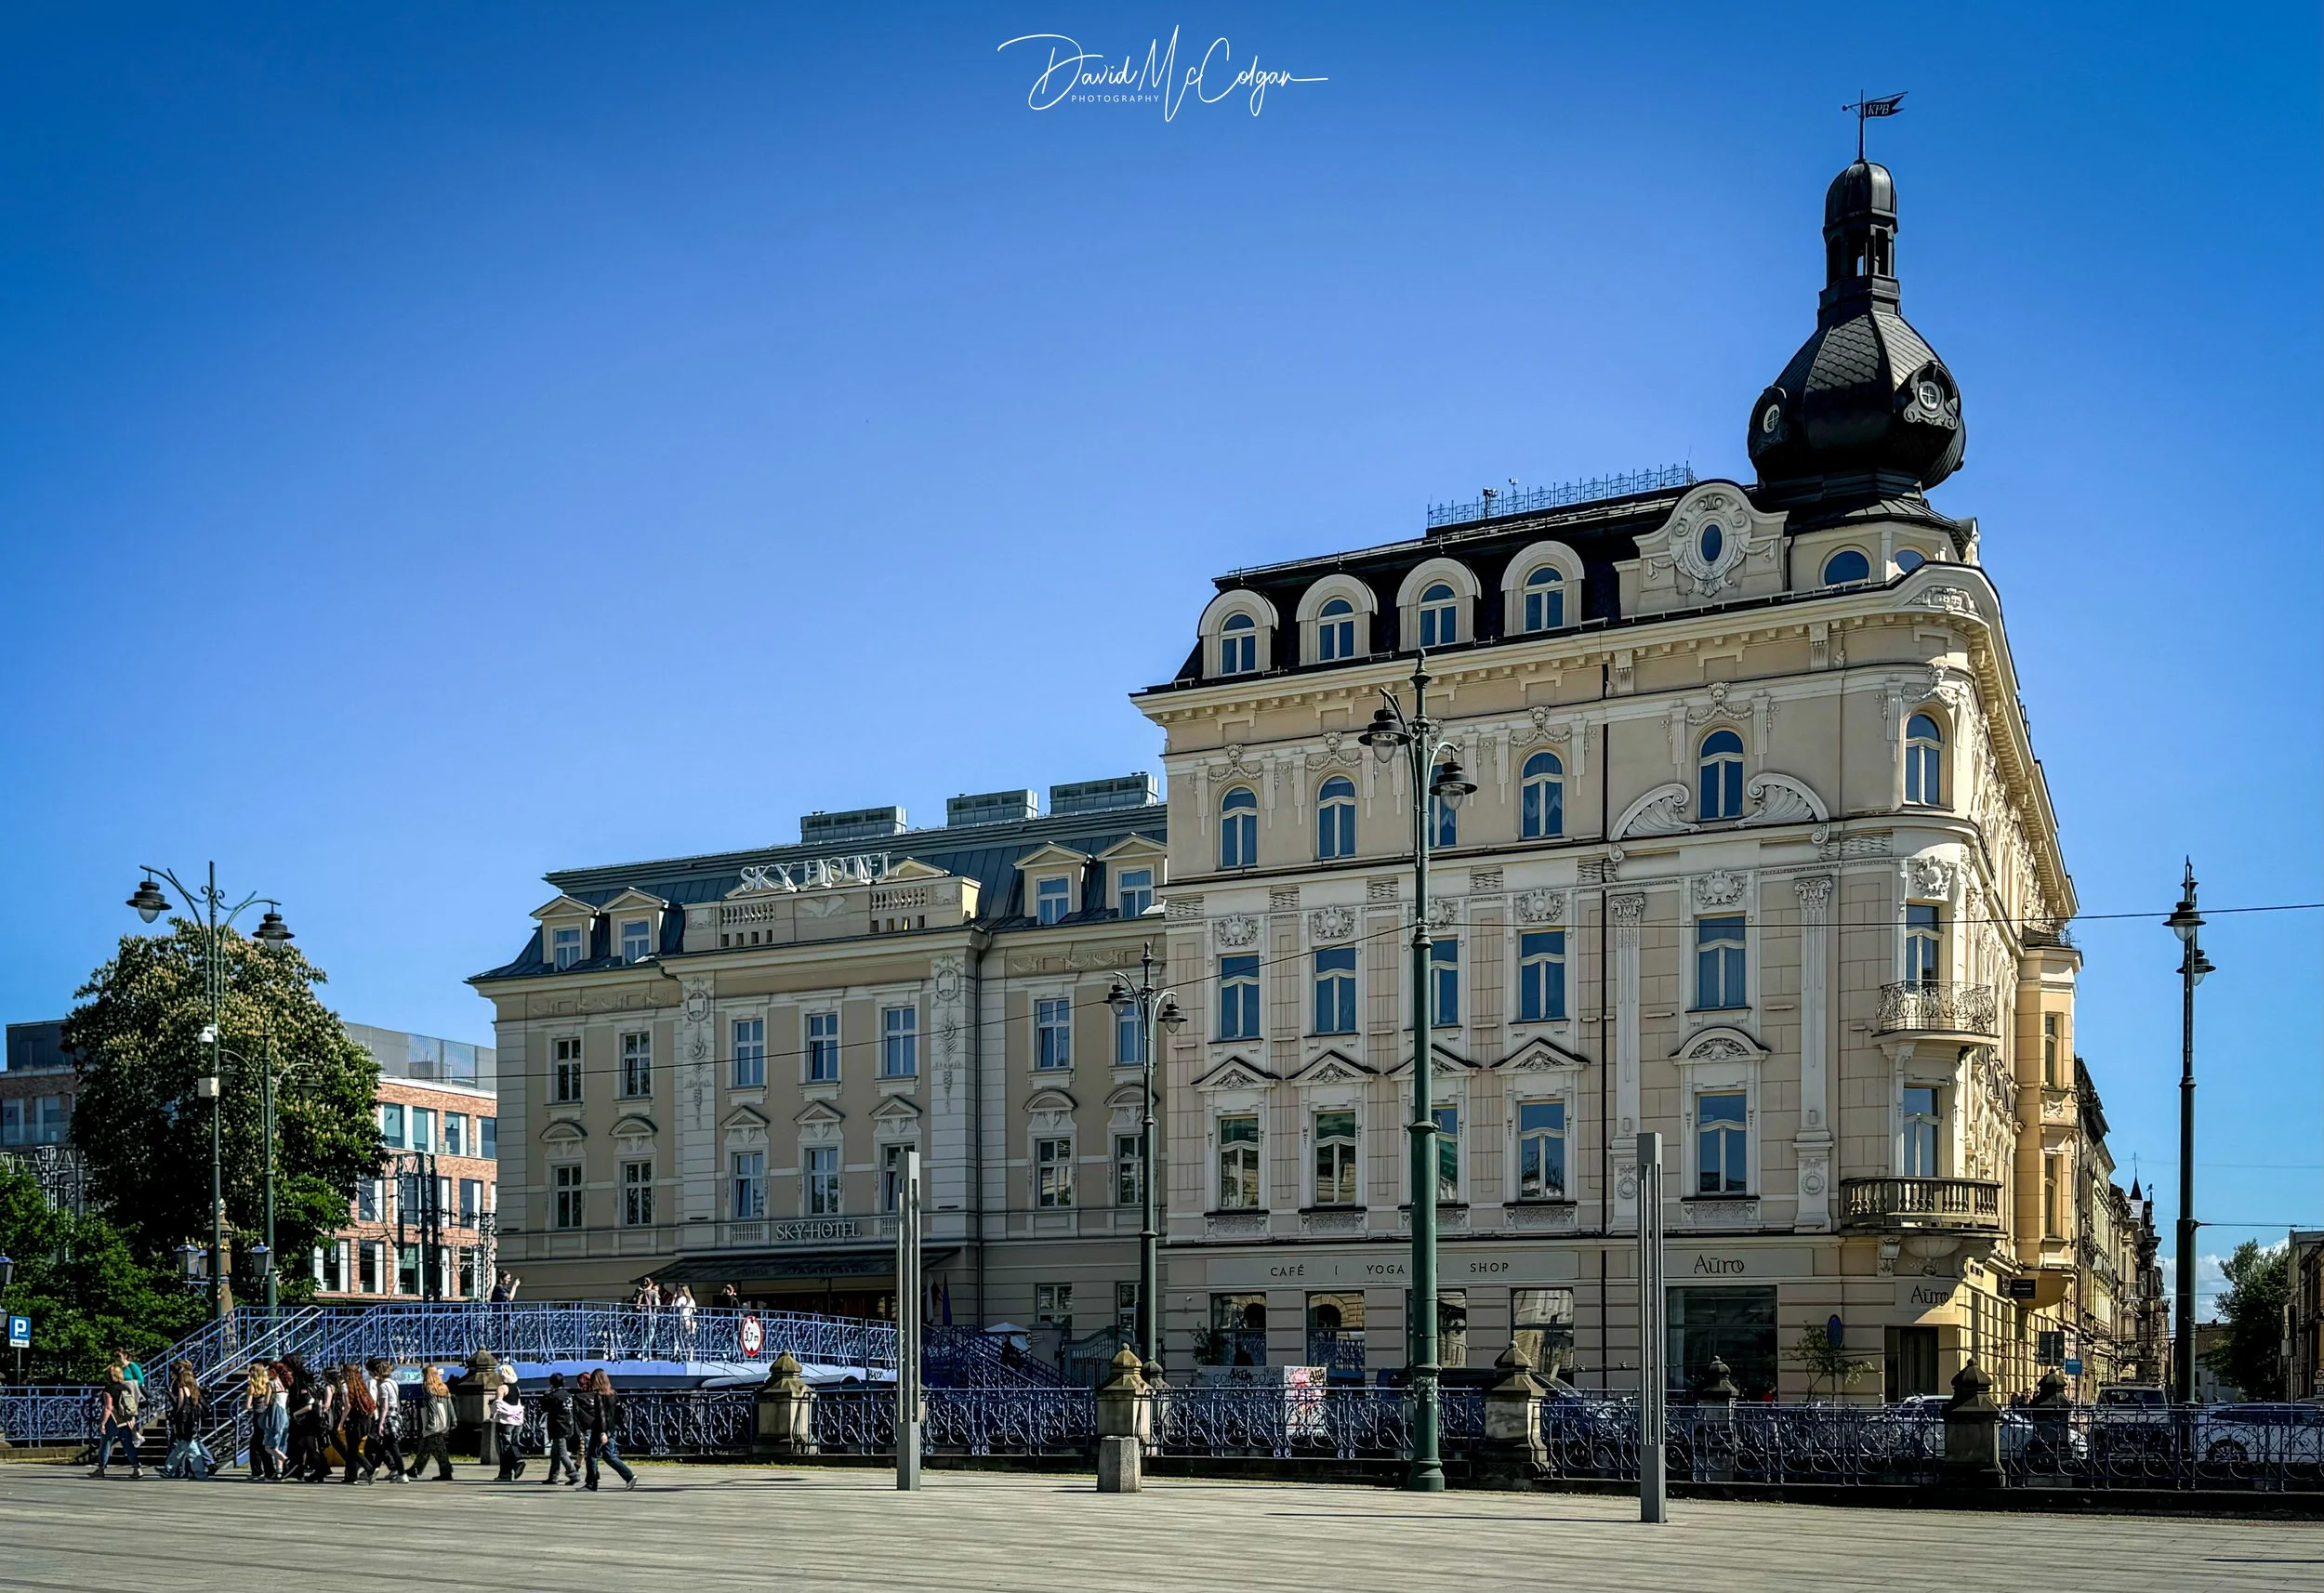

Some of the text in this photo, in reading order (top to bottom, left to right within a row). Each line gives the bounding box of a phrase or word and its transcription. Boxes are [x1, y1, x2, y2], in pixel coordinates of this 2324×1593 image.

[740, 851, 900, 892] SKY HOTEL
[776, 1221, 862, 1240] SKY HOTEL
[1270, 1264, 1305, 1277] CAFÉ
[1366, 1264, 1406, 1274] YOGA
[1470, 1262, 1509, 1272] SHOP
[1694, 1254, 1745, 1274] Aūro
[14, 1319, 27, 1336] P
